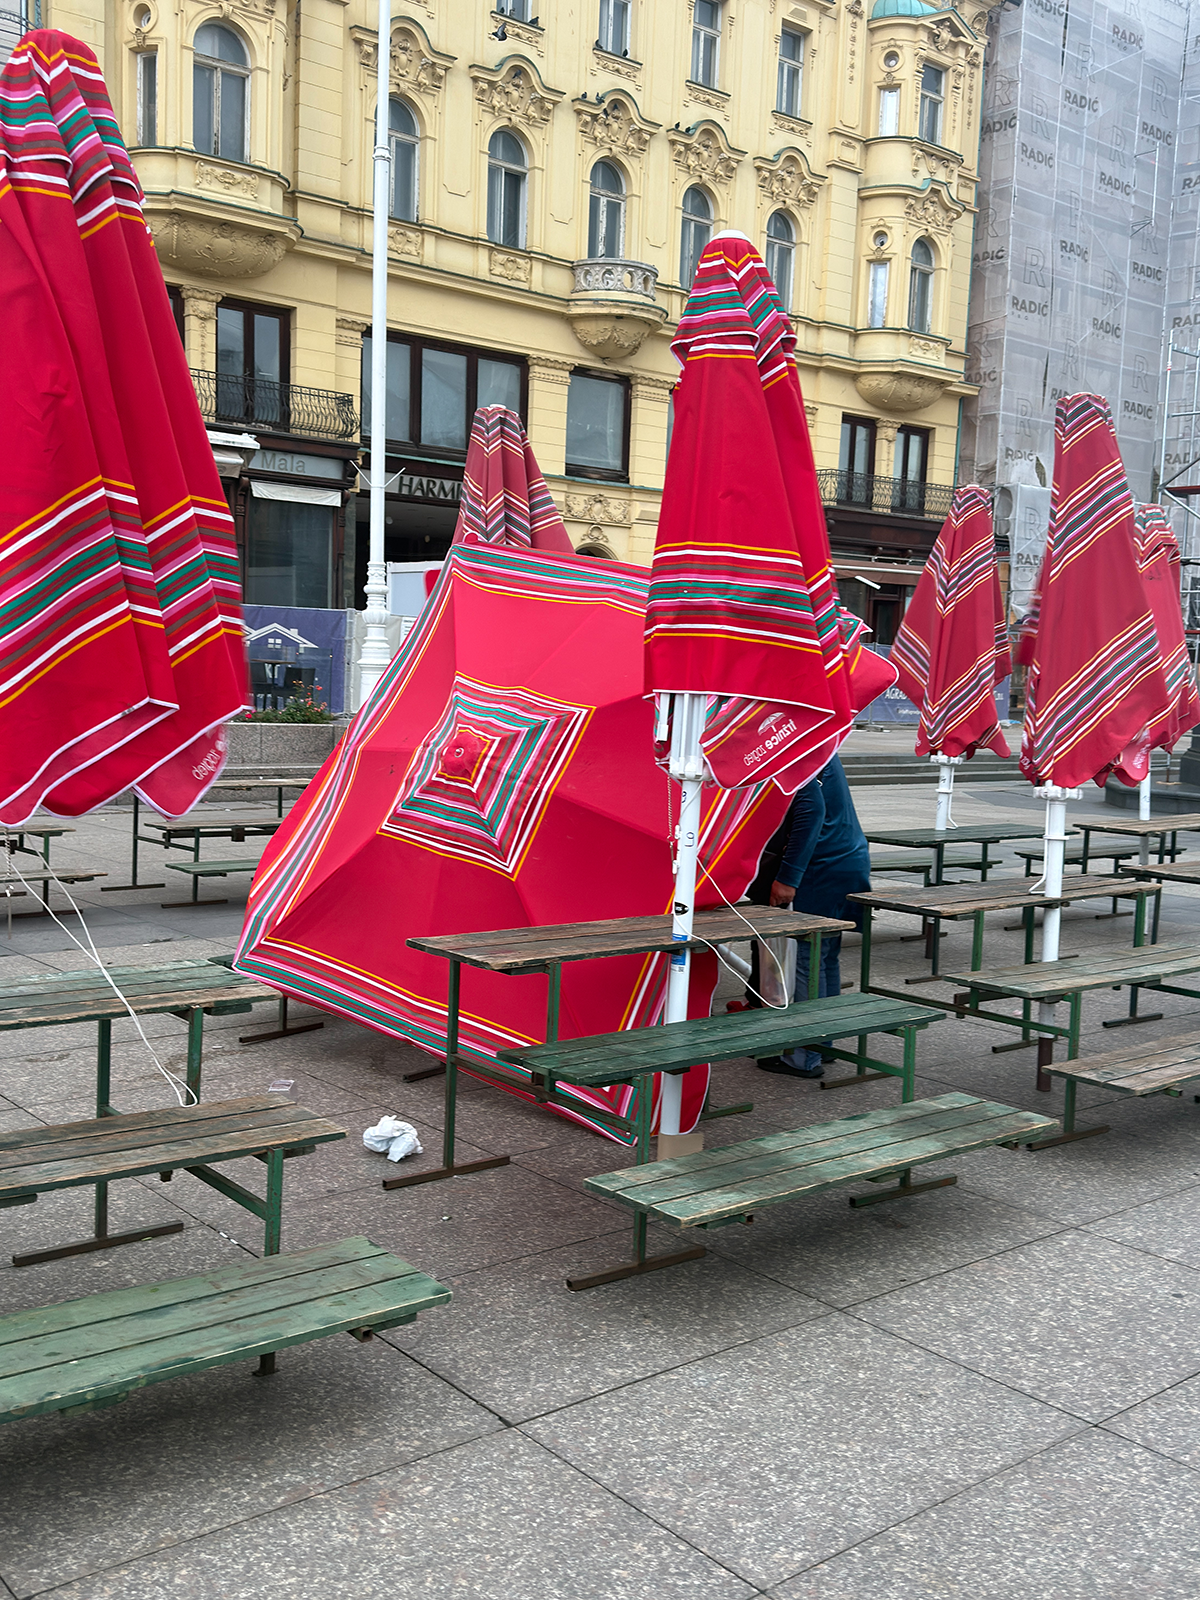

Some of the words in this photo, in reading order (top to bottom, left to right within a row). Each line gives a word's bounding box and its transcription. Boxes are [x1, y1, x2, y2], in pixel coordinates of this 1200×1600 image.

[1064, 89, 1099, 112] RADIĆ
[1142, 121, 1172, 146] RADIĆ
[1021, 142, 1054, 169] RADIĆ
[1100, 171, 1131, 196] RADIĆ
[1060, 239, 1088, 263] RADIĆ
[1133, 261, 1162, 281] RADIĆ
[1012, 295, 1048, 317] RADIĆ
[1092, 317, 1121, 338] RADIĆ
[1124, 400, 1153, 420] RADIĆ
[261, 451, 306, 474] Mala
